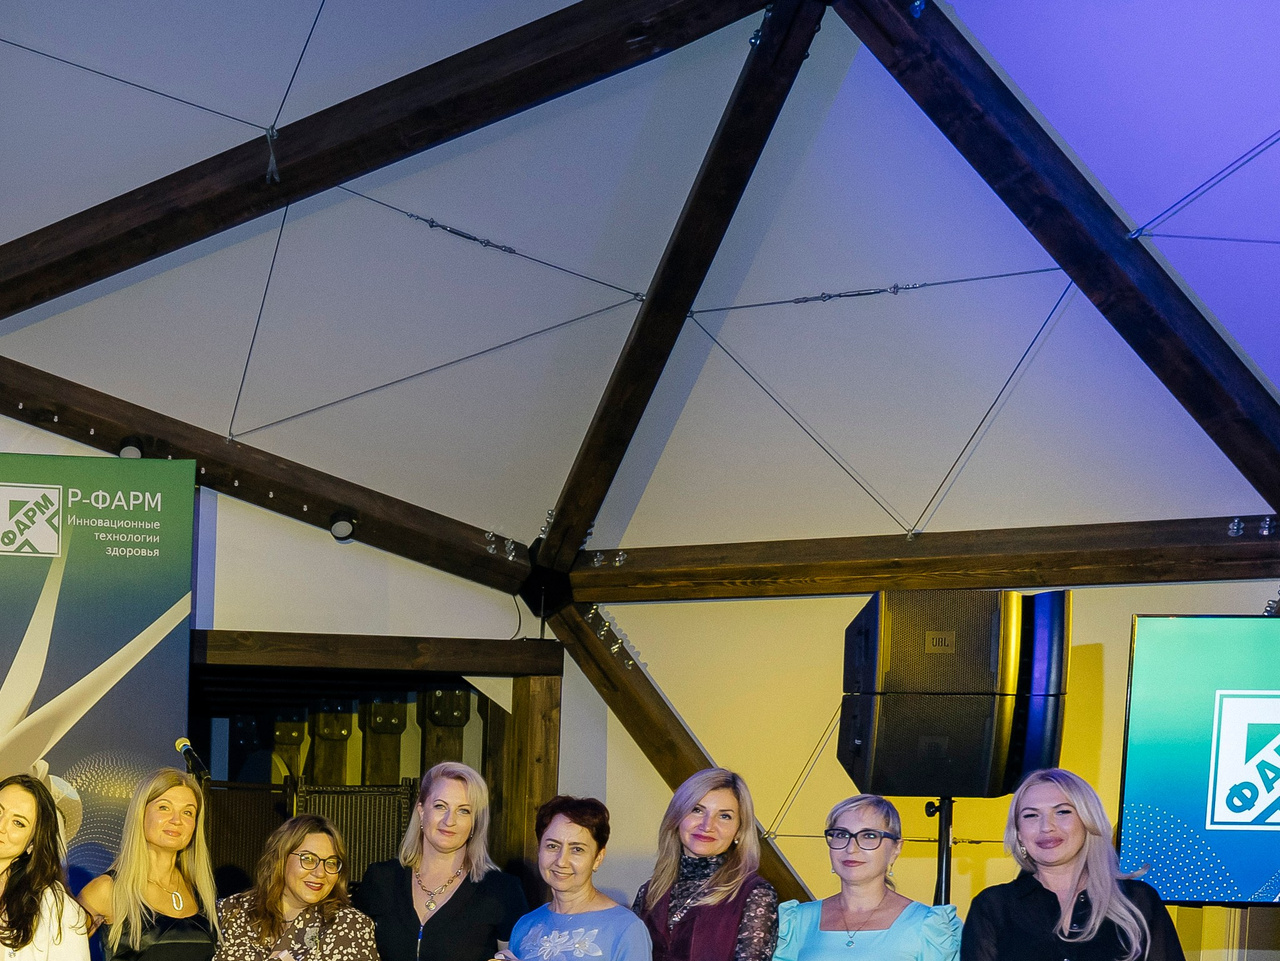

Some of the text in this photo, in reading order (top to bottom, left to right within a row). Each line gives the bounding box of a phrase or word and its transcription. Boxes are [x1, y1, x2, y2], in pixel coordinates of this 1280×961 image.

[68, 488, 162, 512] Р-ФАРМ
[0, 493, 55, 547] ФАРМ
[67, 515, 161, 529] Инновационные
[94, 532, 160, 543] технологии
[105, 546, 160, 558] здоровья
[931, 637, 949, 647] JBL
